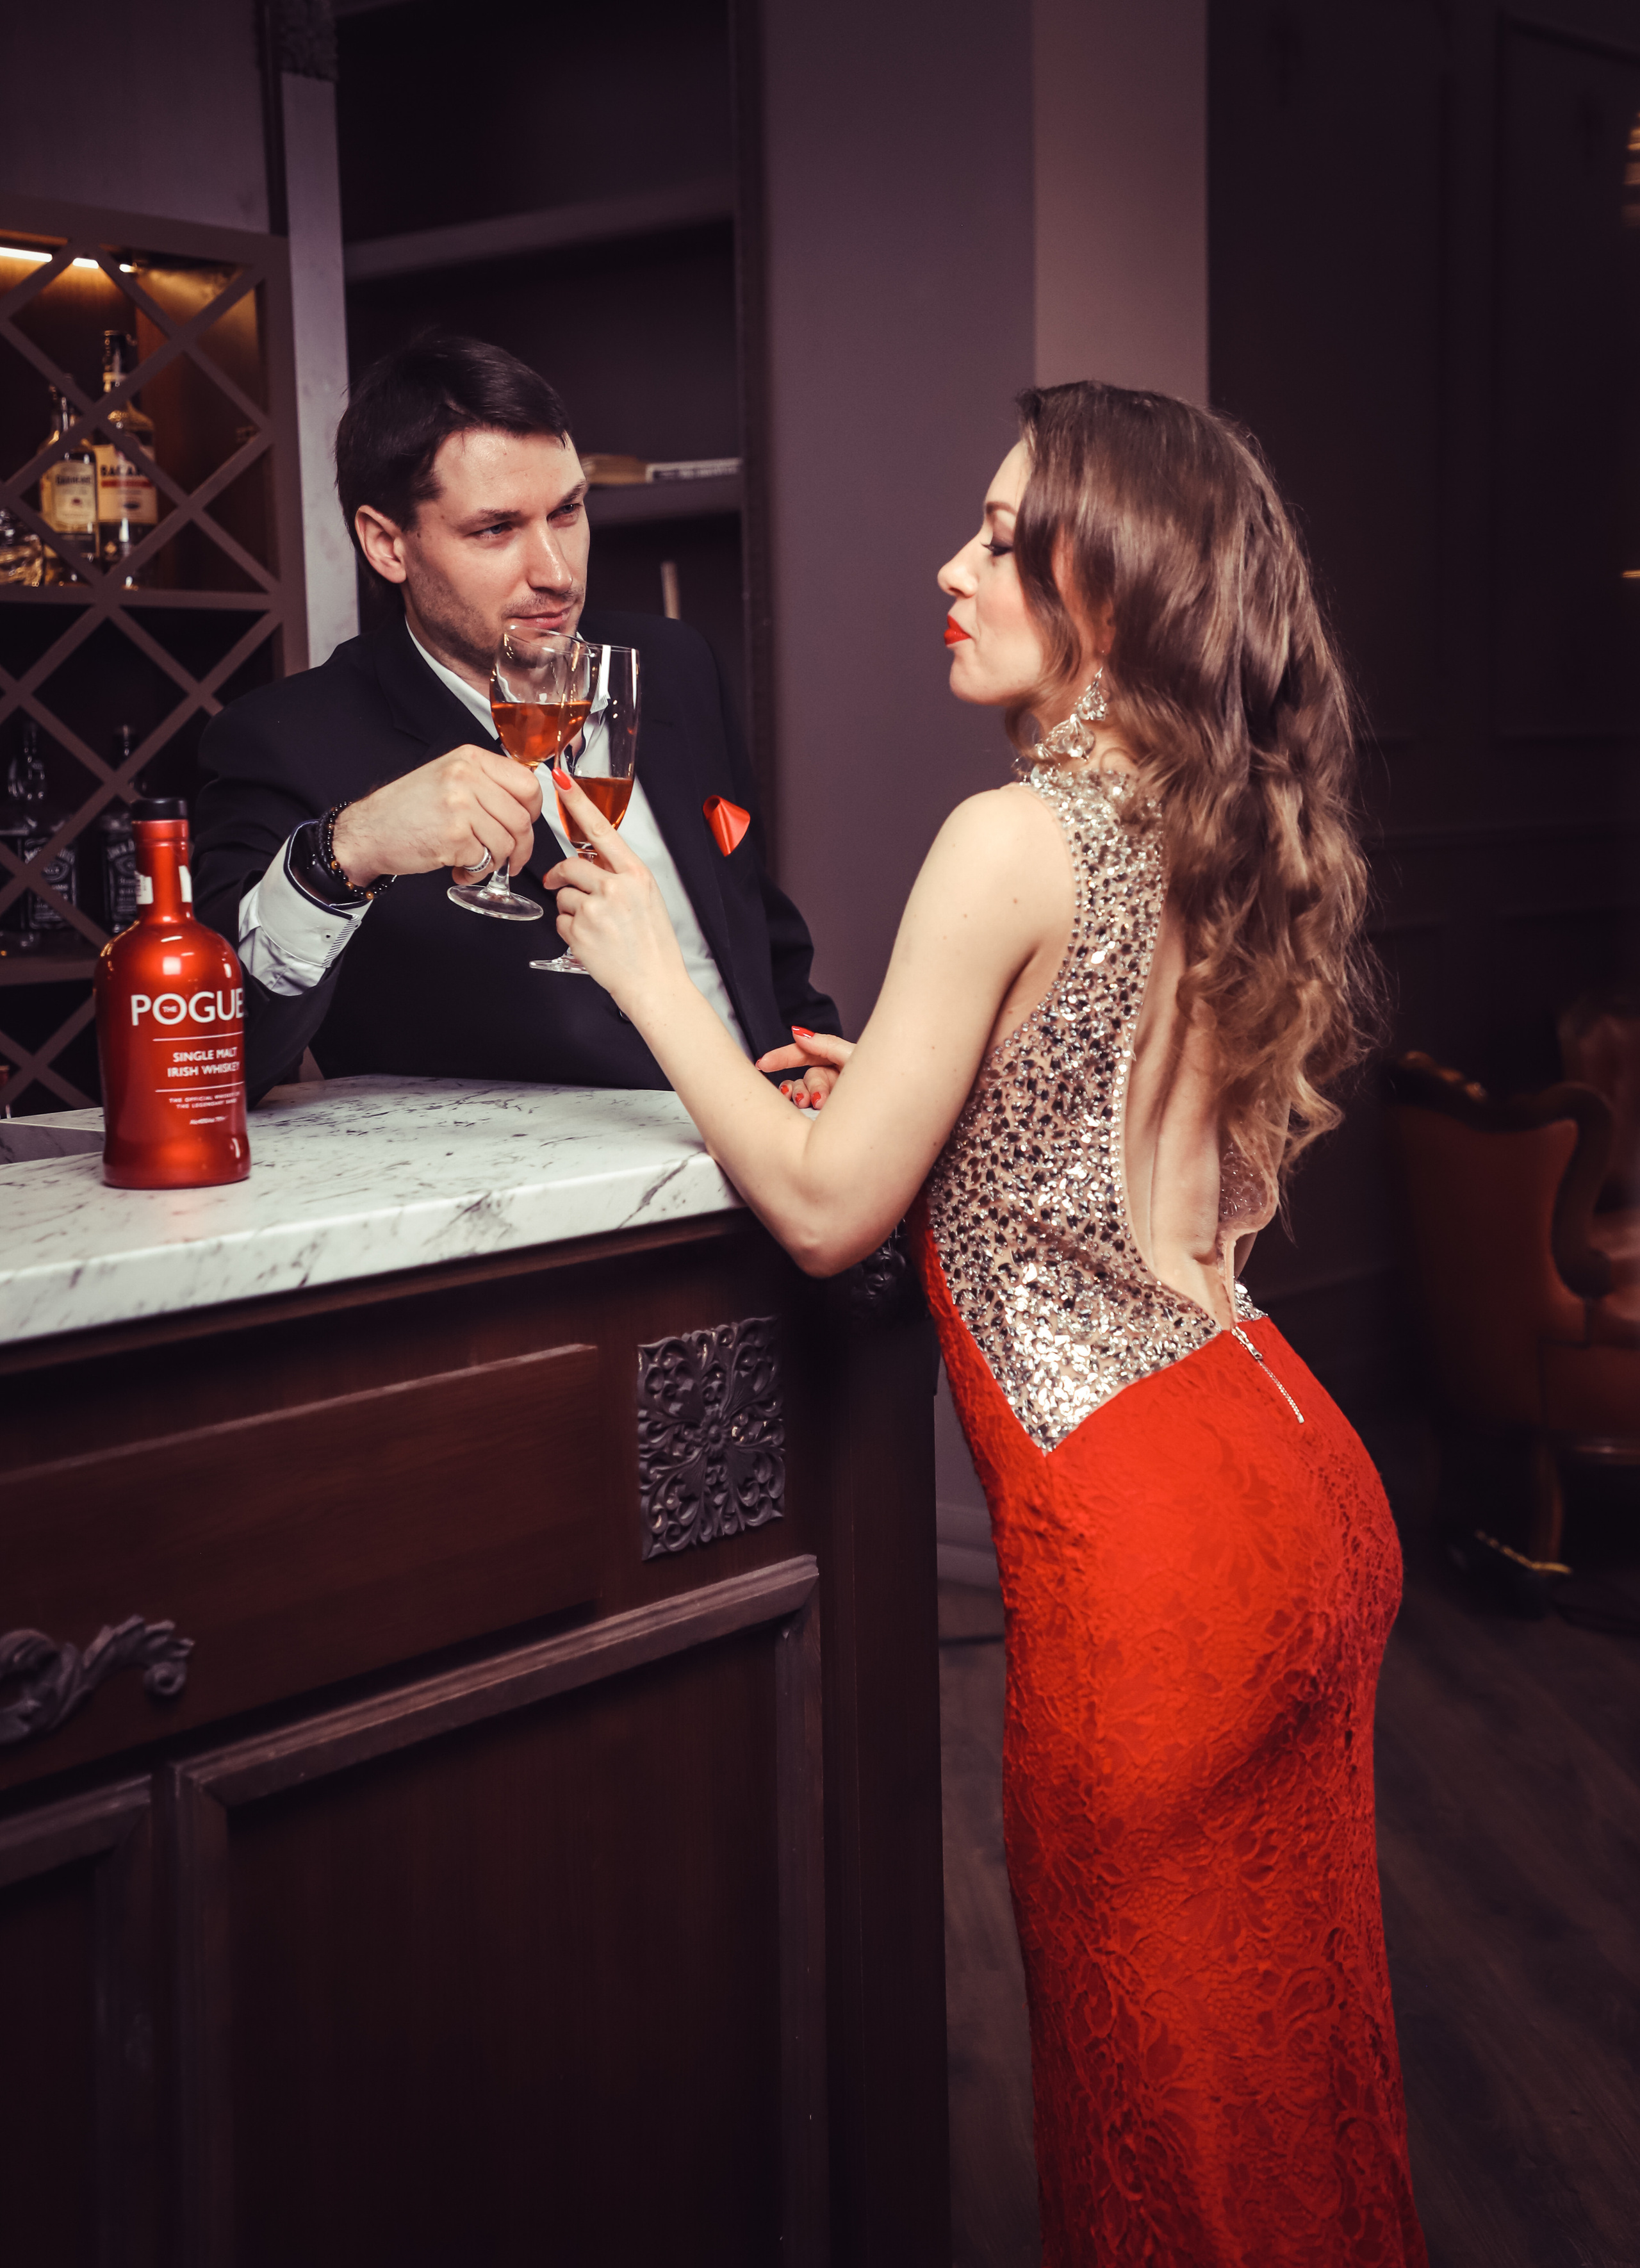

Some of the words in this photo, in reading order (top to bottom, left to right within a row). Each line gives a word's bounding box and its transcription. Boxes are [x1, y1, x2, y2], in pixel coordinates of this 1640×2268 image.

[173, 1050, 215, 1062] SINGLE
[216, 1046, 238, 1058] MALT
[167, 1065, 199, 1077] IRISH
[201, 1061, 240, 1074] WHISKEY
